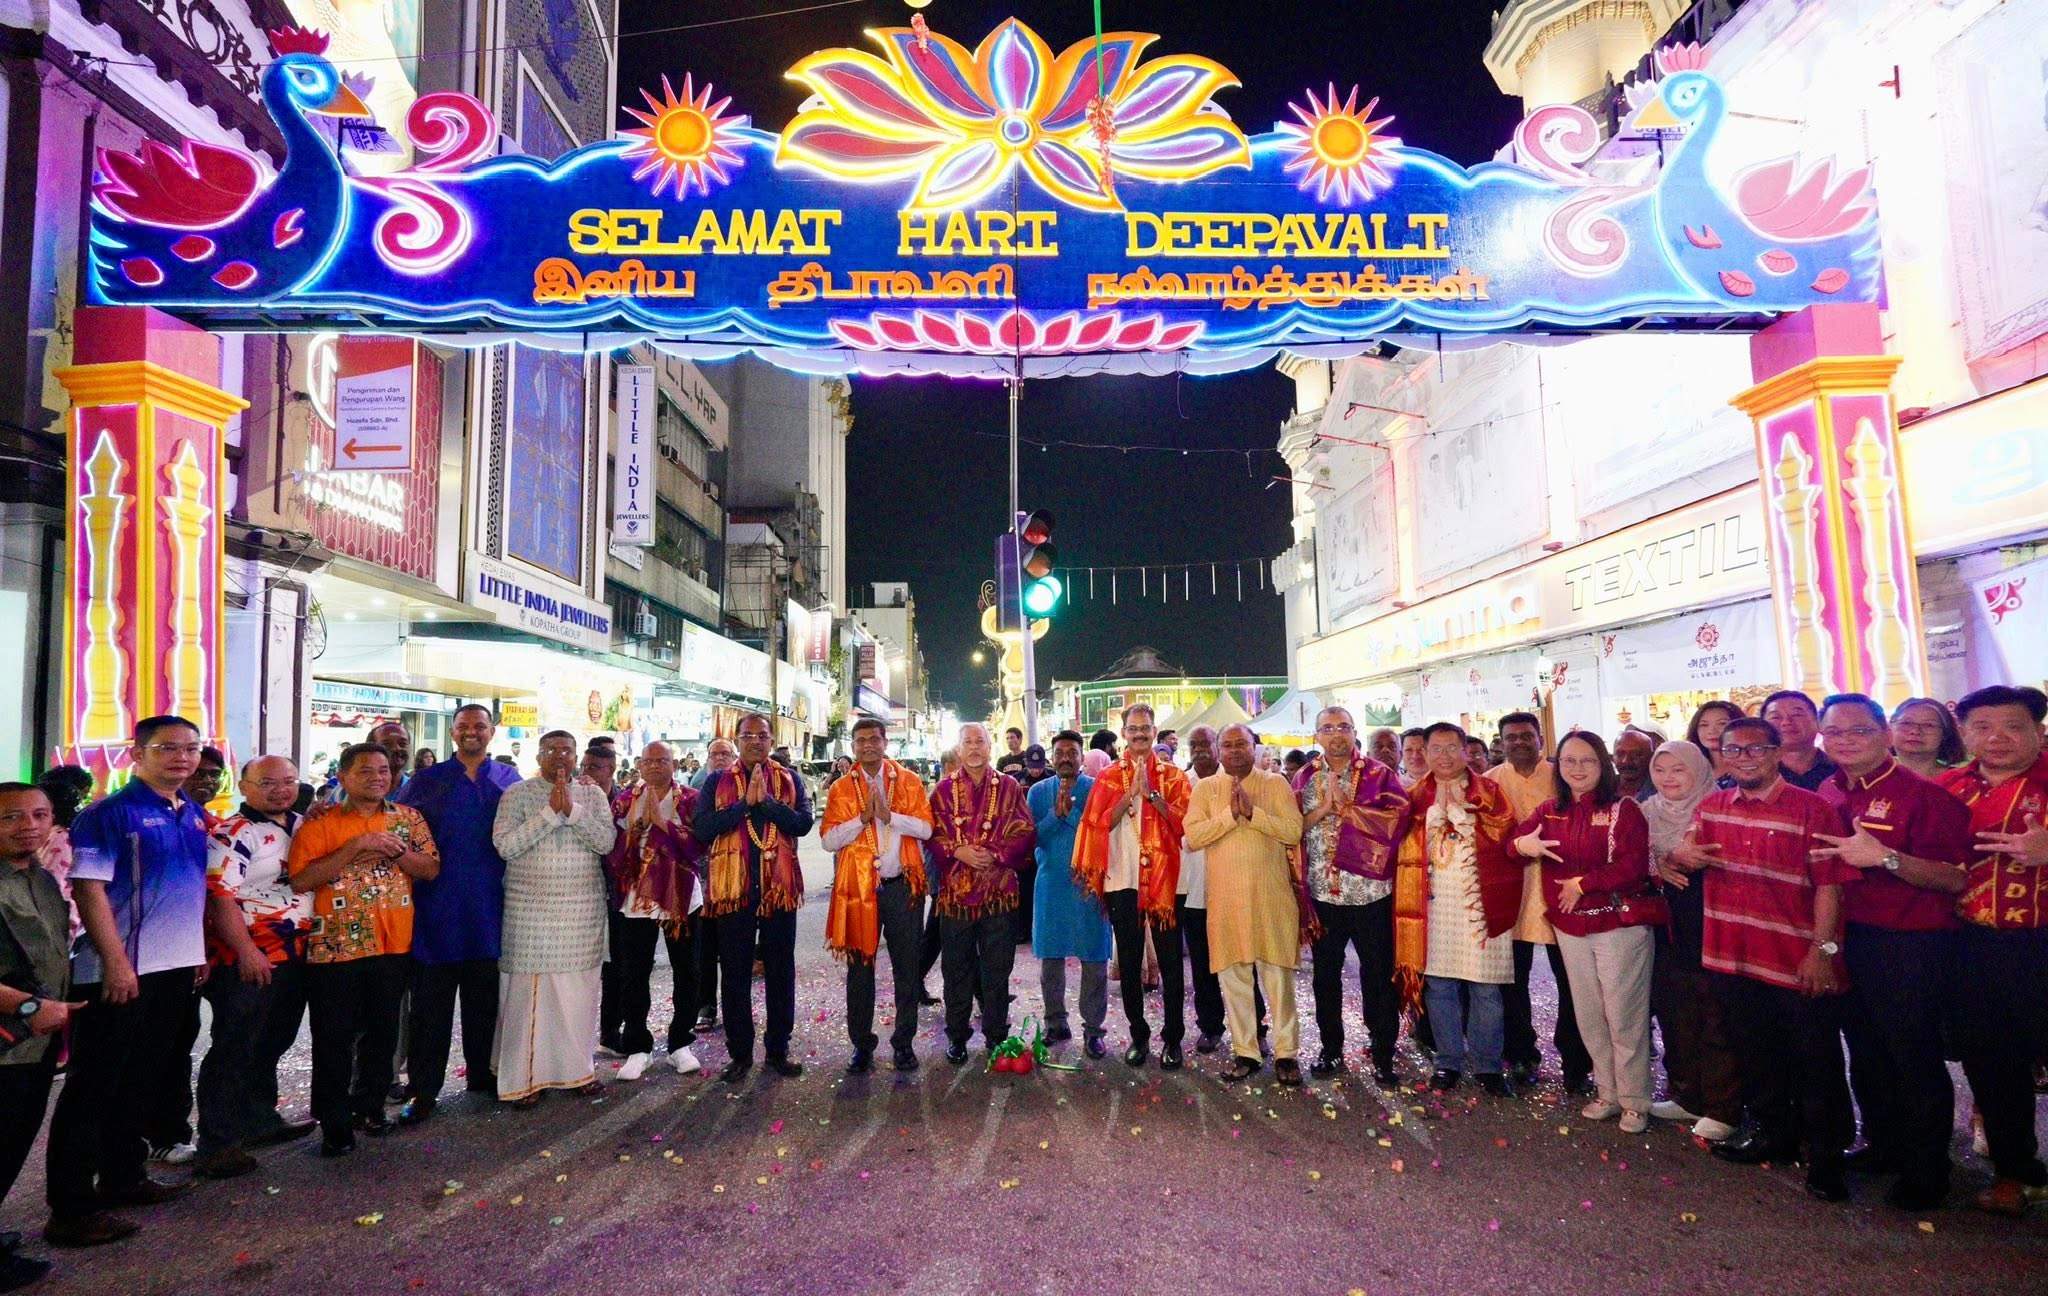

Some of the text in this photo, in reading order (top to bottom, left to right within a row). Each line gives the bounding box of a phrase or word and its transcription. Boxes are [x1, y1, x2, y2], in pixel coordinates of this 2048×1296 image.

[568, 209, 1451, 258] SELAMAT HARI DEEPAVALI
[533, 257, 1491, 310] இனிய தீபாவளி நல்வாழ்த்துக்கள்
[384, 395, 406, 404] Wang
[387, 386, 401, 394] dan
[628, 375, 640, 512] LITTLE INDIA
[616, 513, 649, 521] JEWELLERS
[480, 572, 609, 635] LITTLE INDIA JEWELLERS
